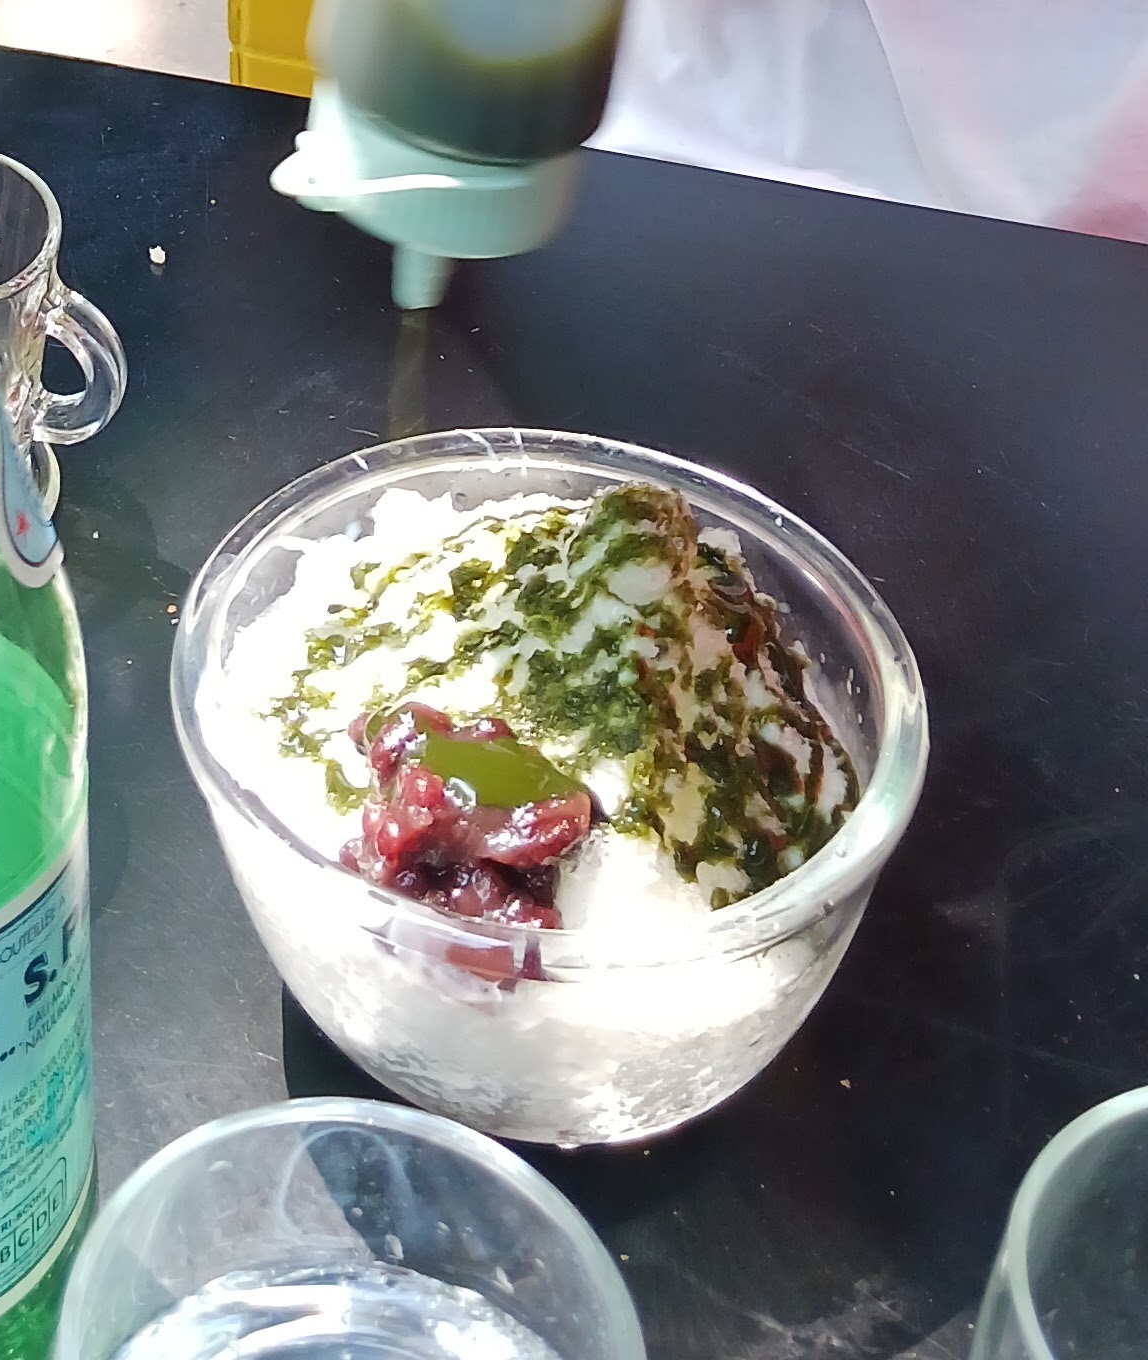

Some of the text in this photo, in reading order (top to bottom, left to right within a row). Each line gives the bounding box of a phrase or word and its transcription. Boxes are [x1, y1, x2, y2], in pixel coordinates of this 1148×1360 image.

[0, 1245, 11, 1264] B
[17, 1227, 30, 1248] C
[36, 1210, 47, 1232] D
